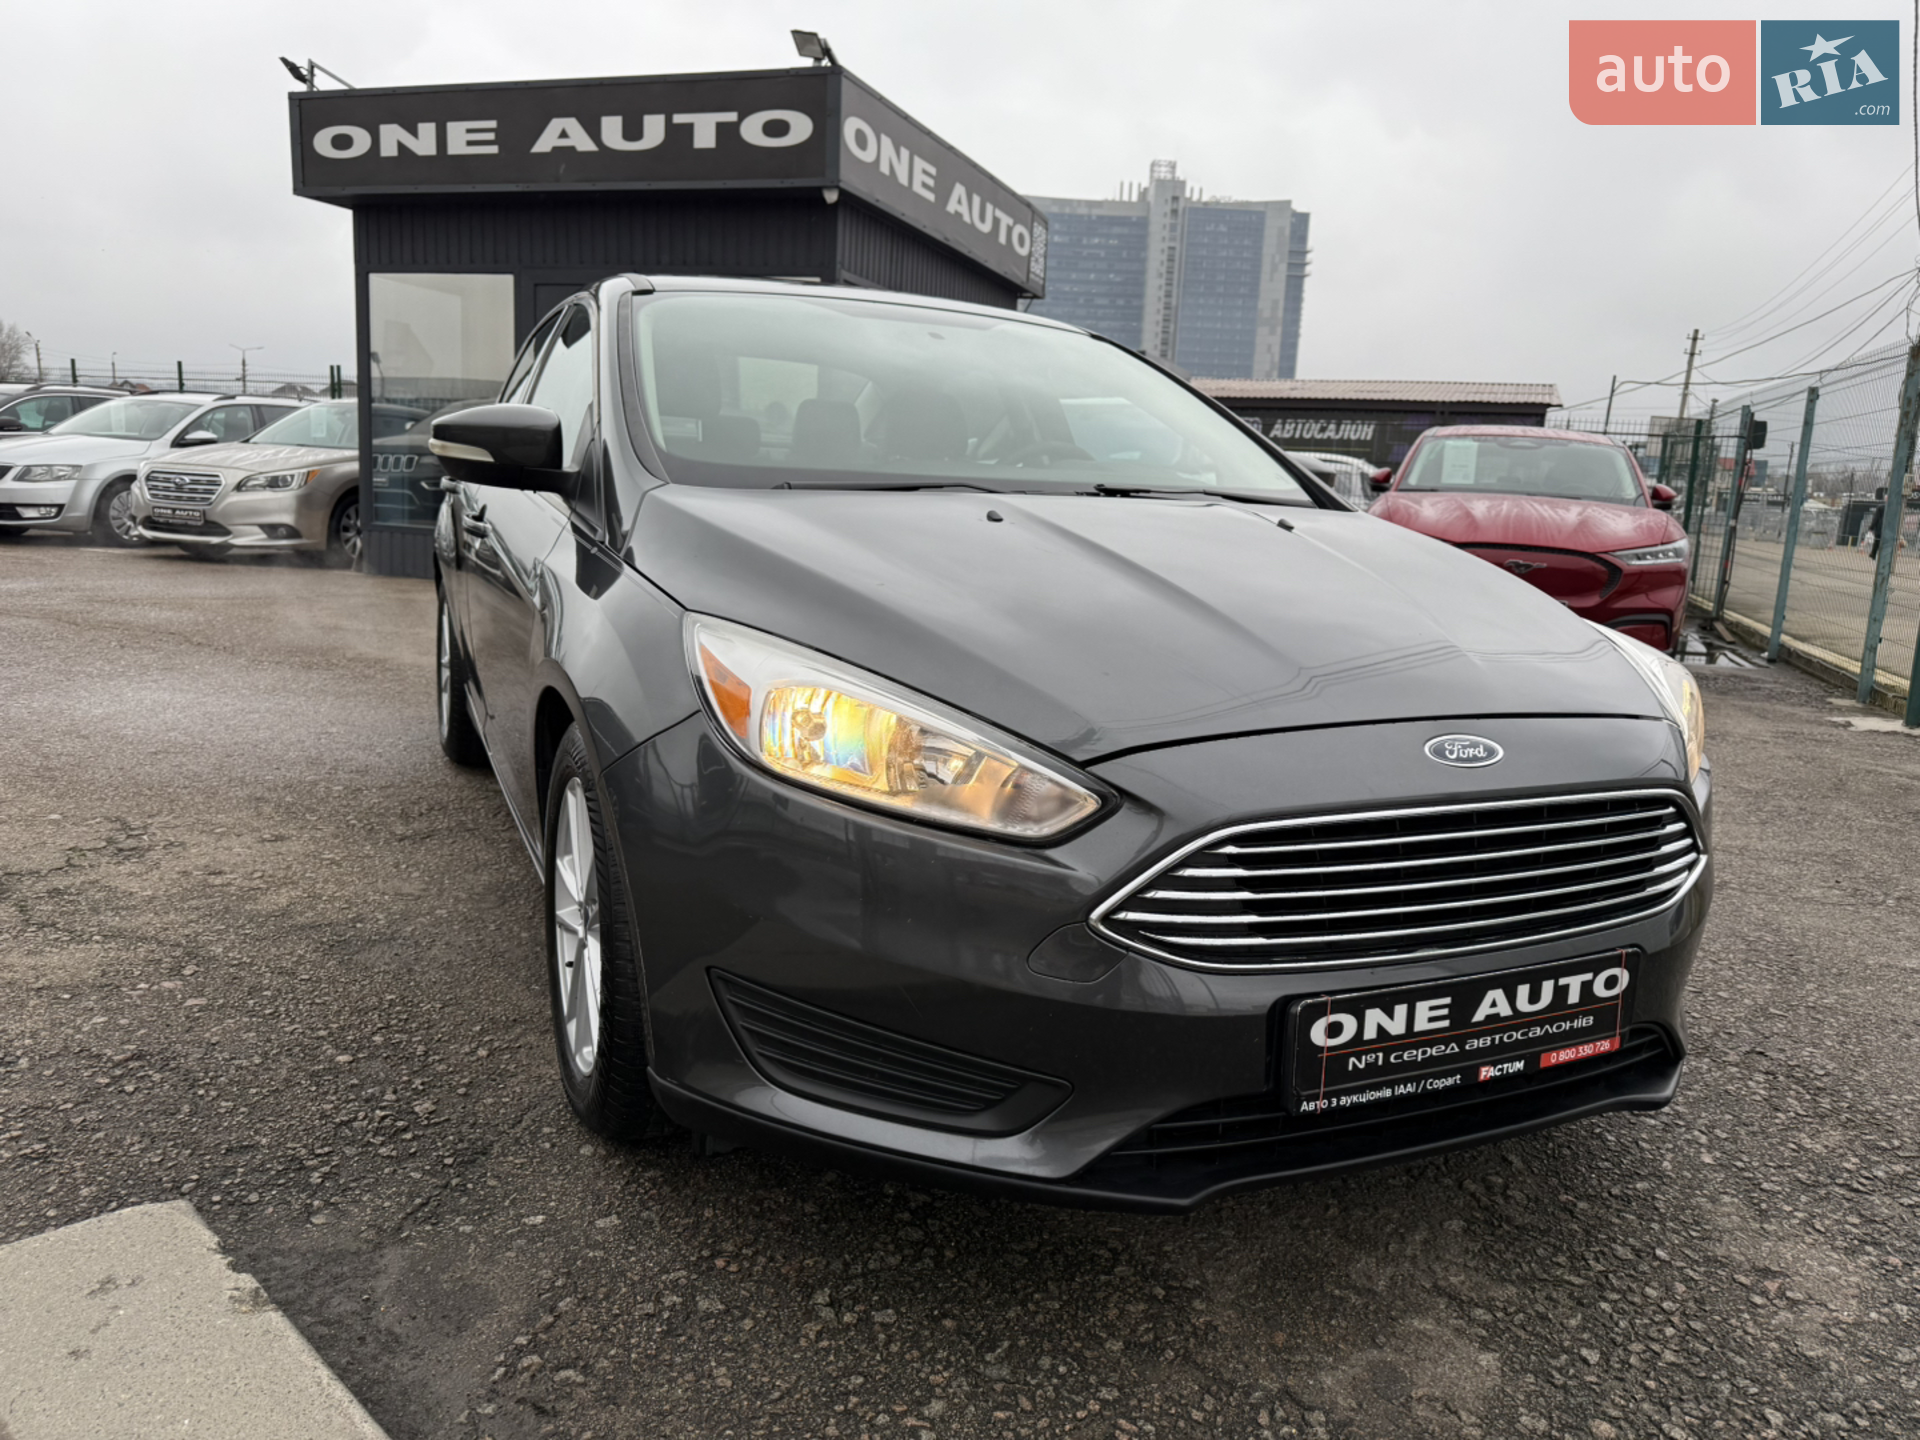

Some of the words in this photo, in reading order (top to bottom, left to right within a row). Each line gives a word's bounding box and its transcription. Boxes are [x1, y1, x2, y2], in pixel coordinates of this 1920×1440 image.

[312, 120, 499, 159] ONE
[529, 109, 814, 153] AUTO
[843, 116, 937, 203] ONE
[945, 182, 1031, 257] AUTO
[1269, 419, 1375, 440] АВТОСАЛОН
[1444, 741, 1487, 759] Ford
[1310, 997, 1452, 1047] ONE
[1470, 967, 1630, 1023] AUTO
[1390, 1042, 1460, 1063] серед
[1465, 1015, 1594, 1050] автосалонів
[1551, 1053, 1557, 1063] 0
[1558, 1048, 1576, 1061] 800
[1577, 1044, 1595, 1056] 330
[1595, 1039, 1611, 1052] 726
[1479, 1060, 1525, 1081] FACTUM
[1300, 1100, 1328, 1112] Авто
[1331, 1098, 1337, 1107] з
[1339, 1087, 1393, 1107] аукціонів
[1417, 1080, 1425, 1093] /
[1426, 1074, 1462, 1090] Copart
